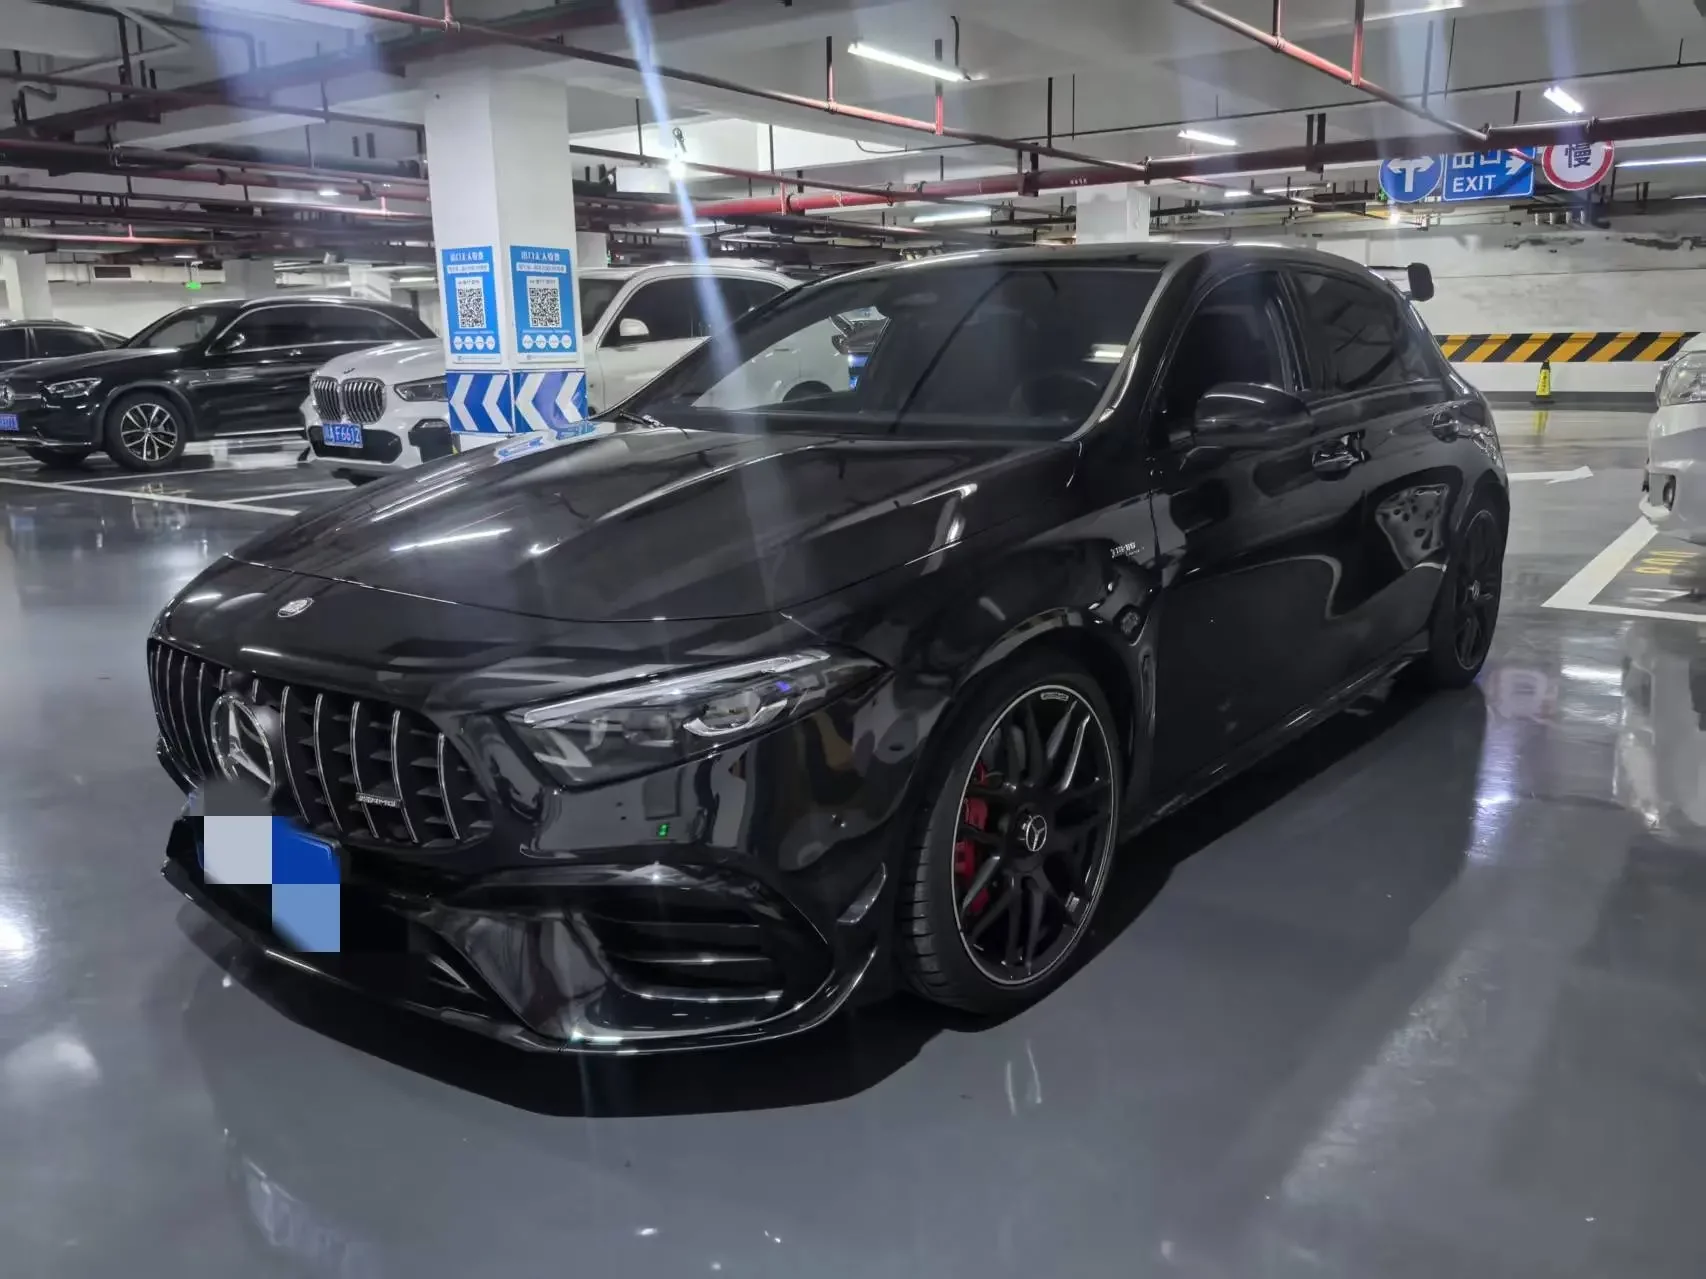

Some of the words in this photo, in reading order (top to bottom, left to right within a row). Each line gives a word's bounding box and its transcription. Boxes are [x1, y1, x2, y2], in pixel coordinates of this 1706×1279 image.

[1452, 149, 1501, 169] 出口
[1564, 143, 1592, 168] 慢
[1452, 174, 1497, 193] EXIT
